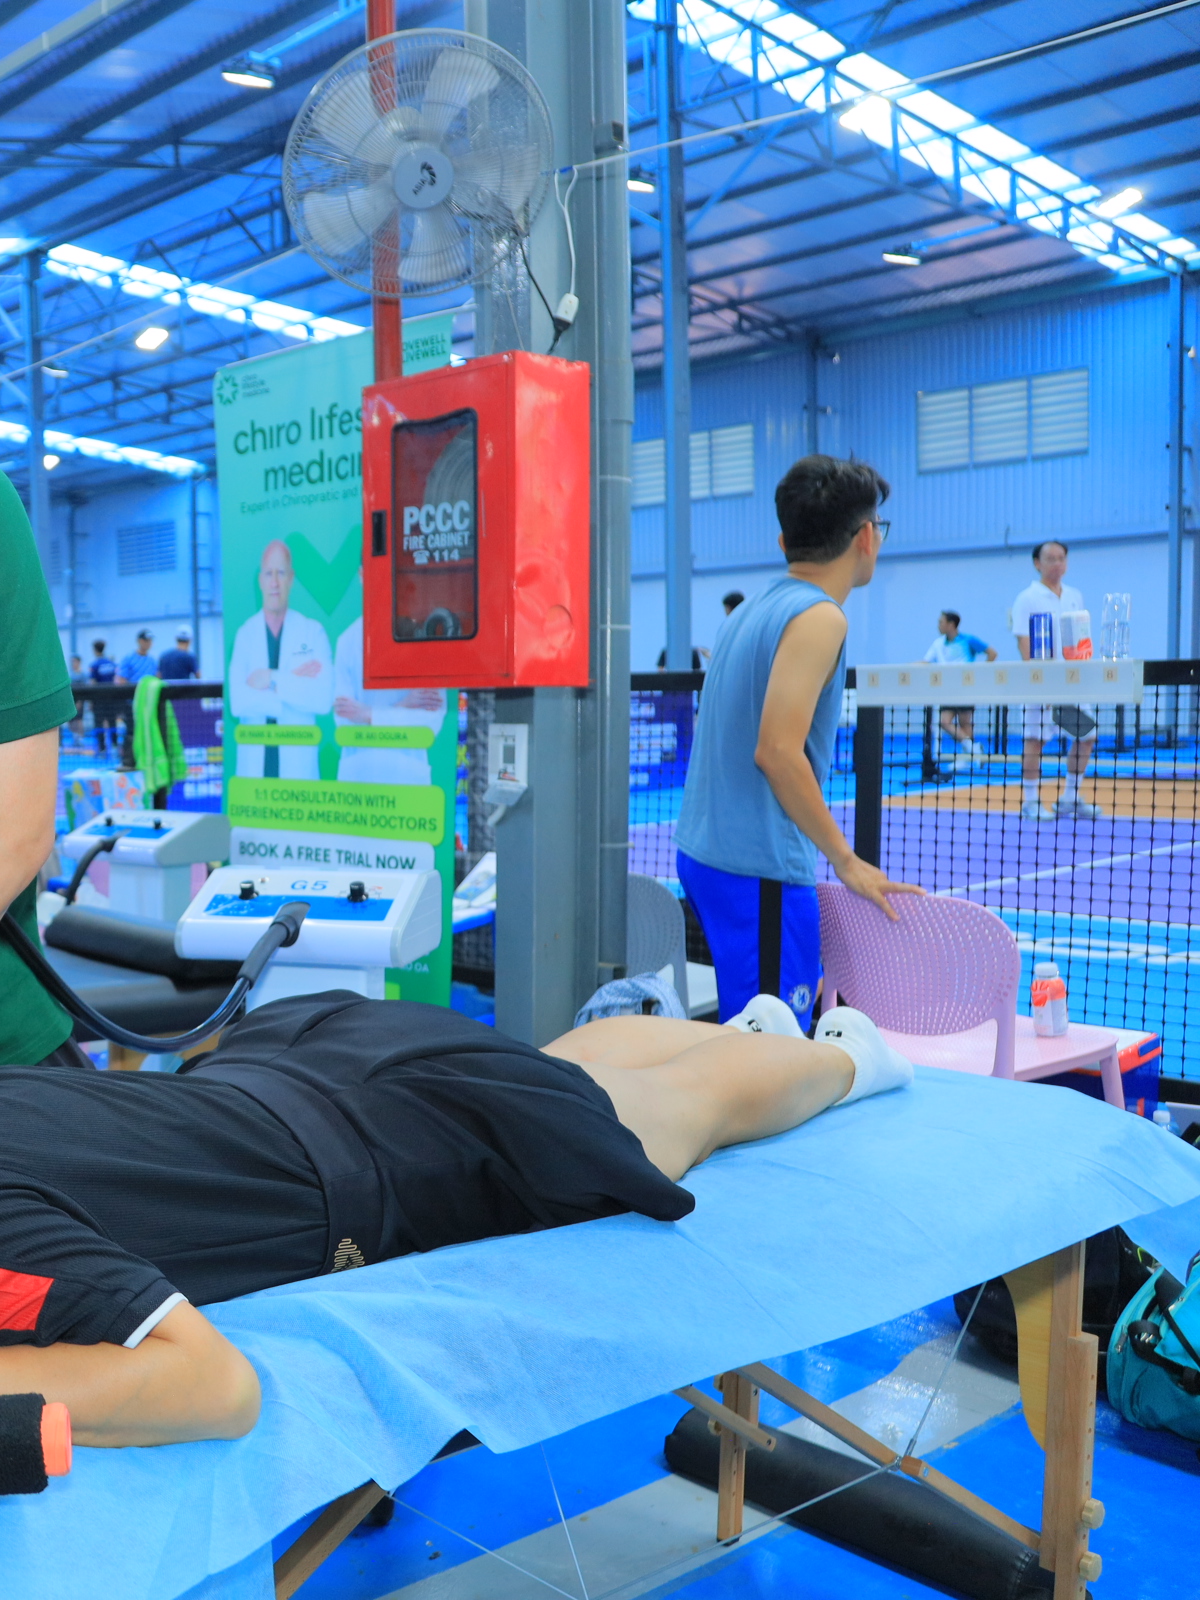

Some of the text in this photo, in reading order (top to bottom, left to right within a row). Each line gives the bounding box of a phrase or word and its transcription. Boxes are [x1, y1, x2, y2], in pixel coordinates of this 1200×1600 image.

[233, 419, 302, 455] chiro
[240, 500, 270, 514] Expert
[403, 500, 470, 535] PCCC
[403, 530, 470, 552] FIRE CABINET
[433, 548, 460, 563] 114
[270, 788, 362, 807] CONSULTATION
[365, 794, 397, 809] WITH
[230, 804, 437, 832] EXPERIENCED AMERICAN DOCTORS
[238, 841, 416, 870] BOOK A FREE TRIAL NOW
[290, 879, 329, 891] G5
